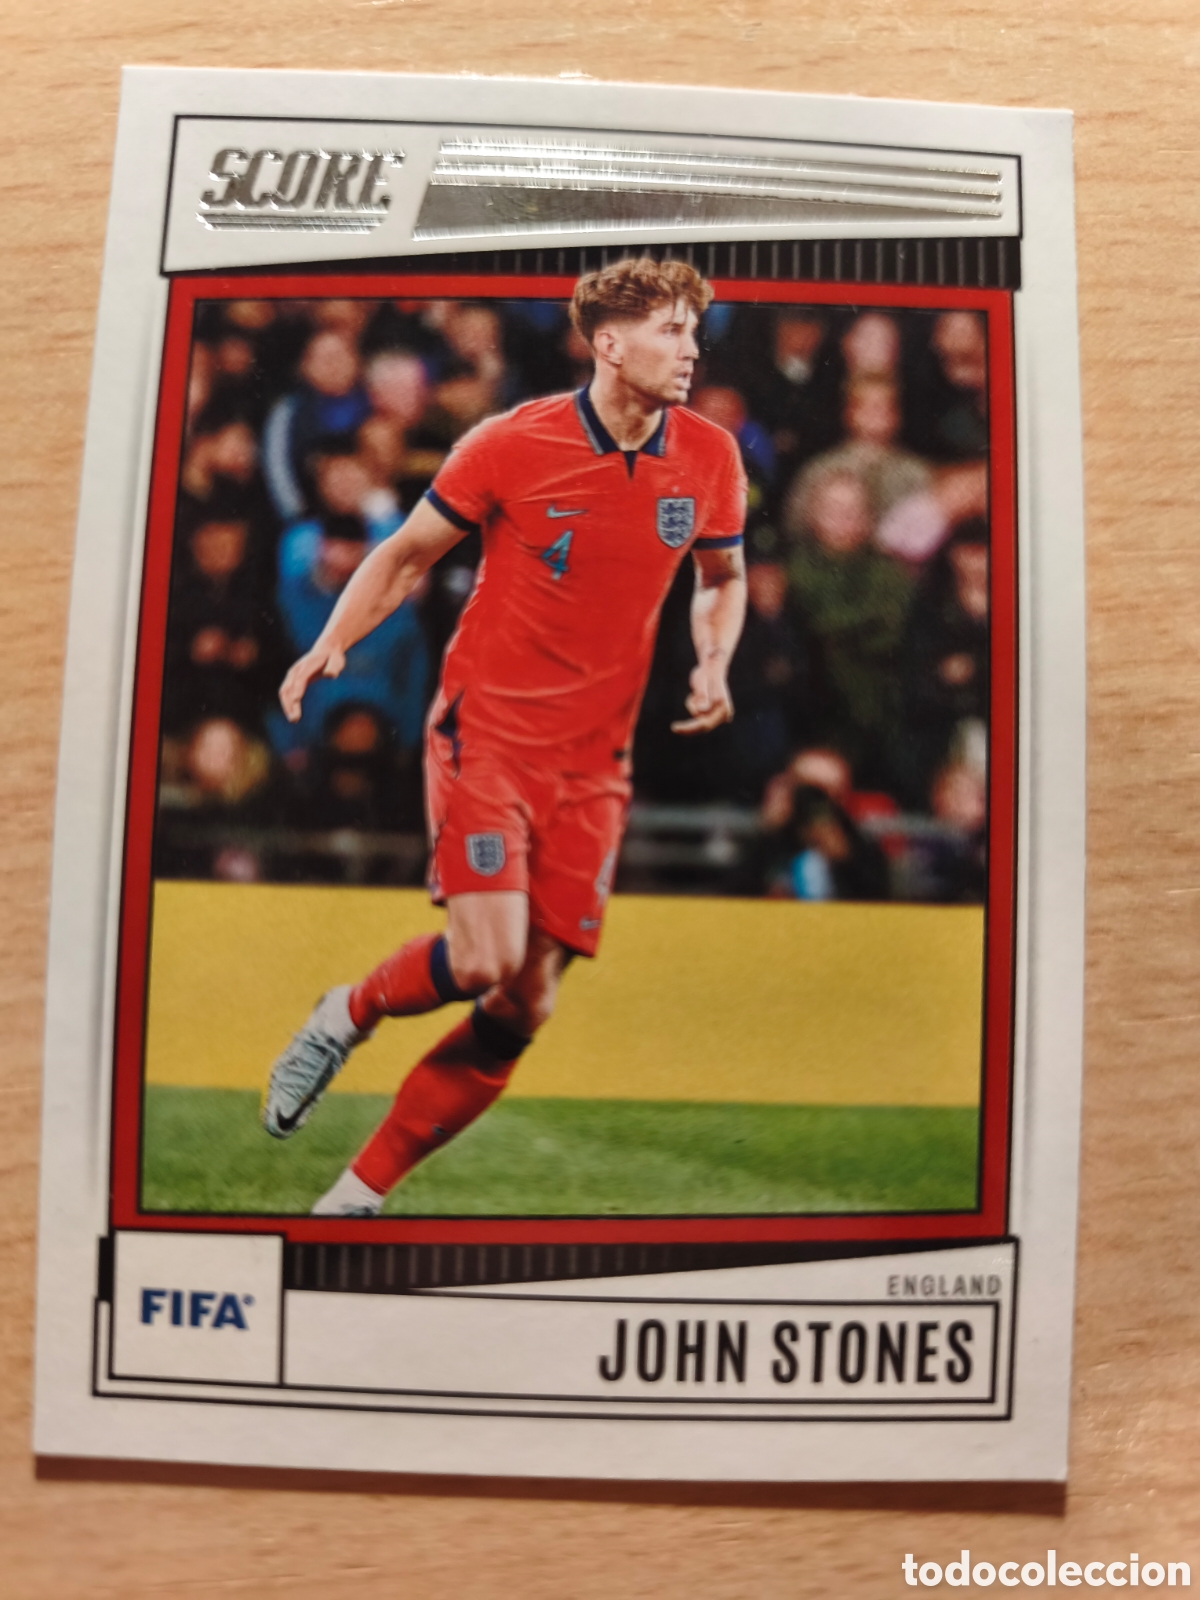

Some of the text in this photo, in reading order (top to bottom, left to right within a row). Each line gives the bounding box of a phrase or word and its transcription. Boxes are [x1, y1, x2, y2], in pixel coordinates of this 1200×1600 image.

[199, 148, 404, 212] SCORE
[541, 530, 573, 580] 4
[886, 1274, 1001, 1297] ENGLAND
[598, 1318, 974, 1385] JOHN STONES
